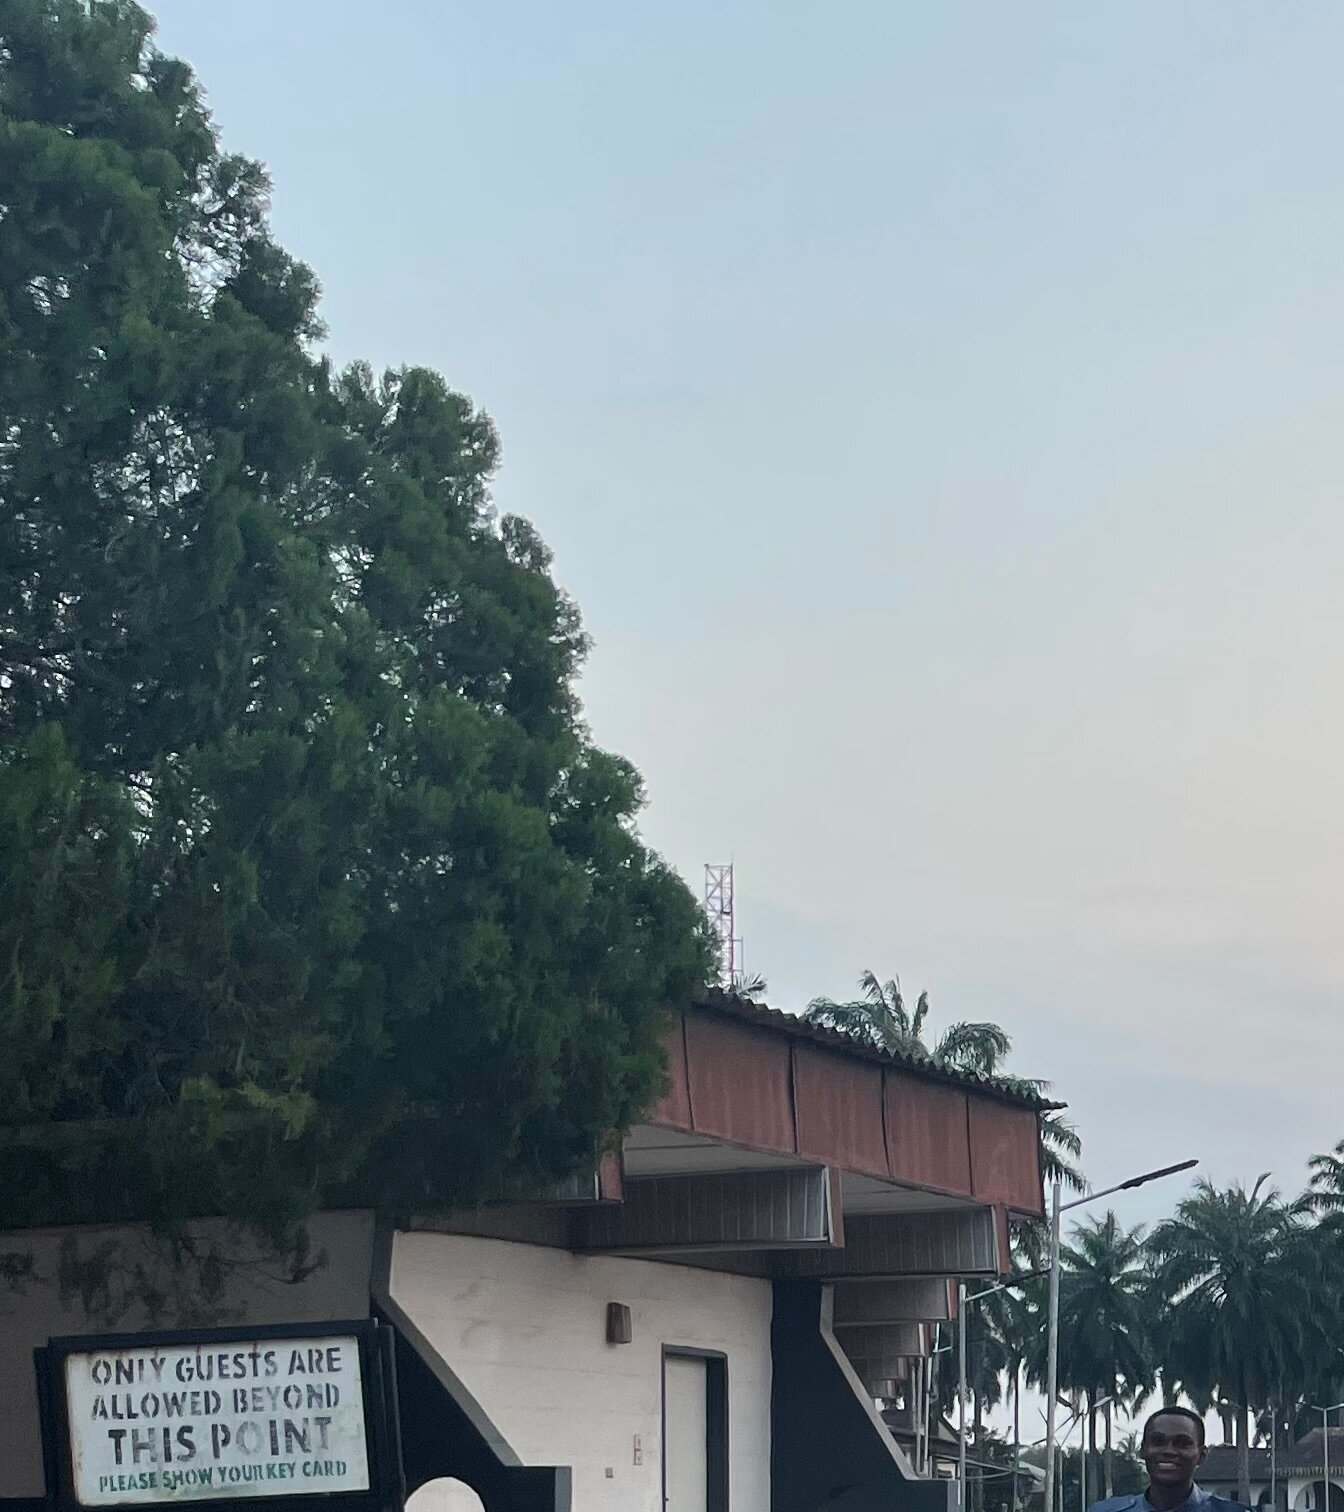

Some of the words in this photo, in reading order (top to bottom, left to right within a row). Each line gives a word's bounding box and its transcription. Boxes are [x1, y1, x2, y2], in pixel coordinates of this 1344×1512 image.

[175, 1350, 278, 1383] GUESTS
[288, 1347, 342, 1375] ARE
[91, 1390, 221, 1421] ALLOWED
[233, 1382, 340, 1413] BEYOND
[108, 1425, 197, 1465] THIS
[212, 1416, 332, 1459] POINT
[99, 1472, 158, 1493] PLEASE
[162, 1466, 213, 1490] SHOW
[217, 1464, 264, 1483] YOUR
[266, 1462, 297, 1479] KEY
[302, 1460, 347, 1478] CARD
